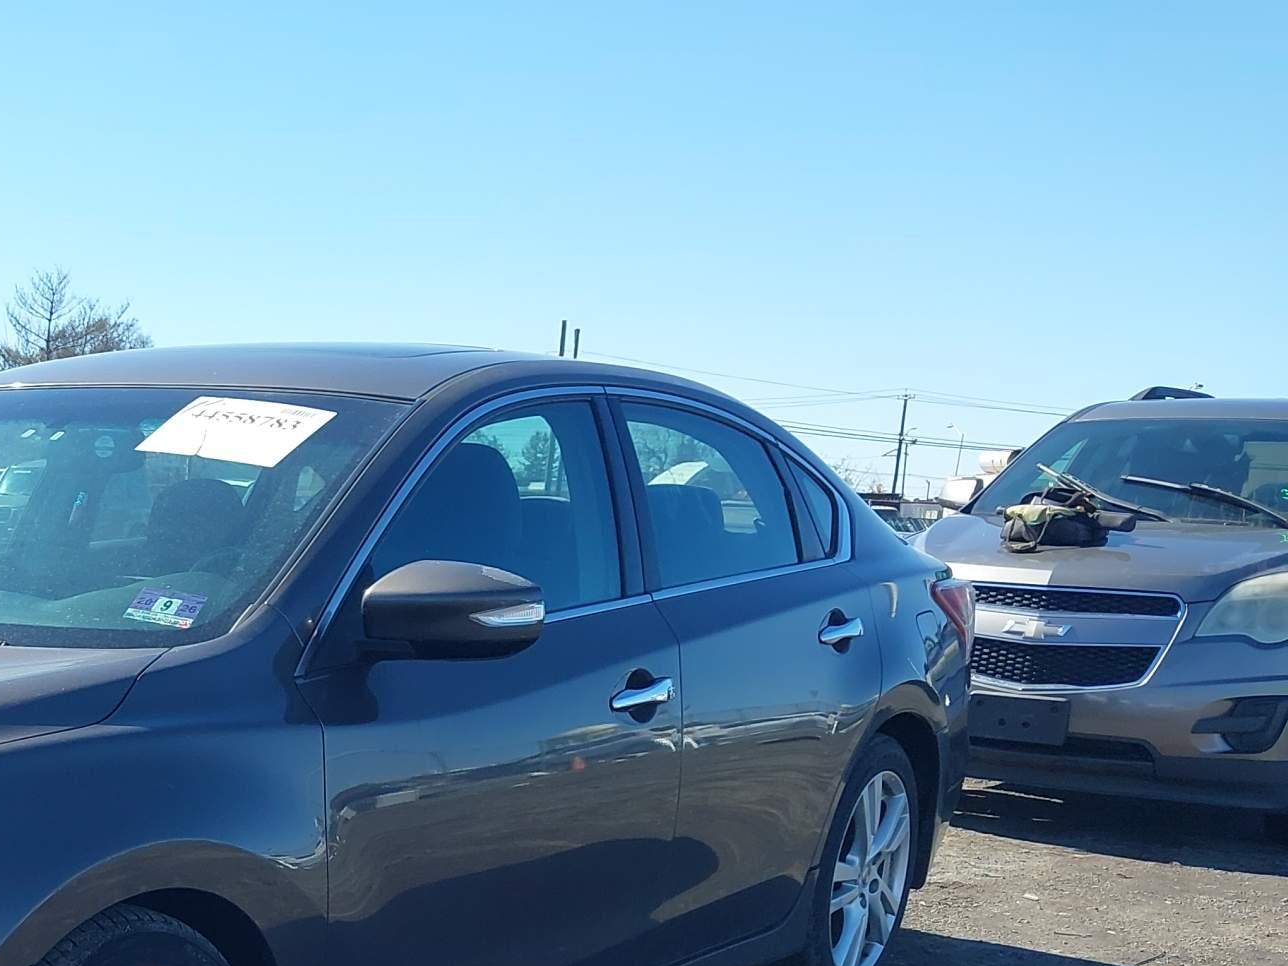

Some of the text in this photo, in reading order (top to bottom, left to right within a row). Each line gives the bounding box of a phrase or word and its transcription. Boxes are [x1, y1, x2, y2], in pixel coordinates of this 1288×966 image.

[191, 409, 304, 431] 44558783
[160, 599, 174, 611] 9
[180, 604, 198, 614] 26
